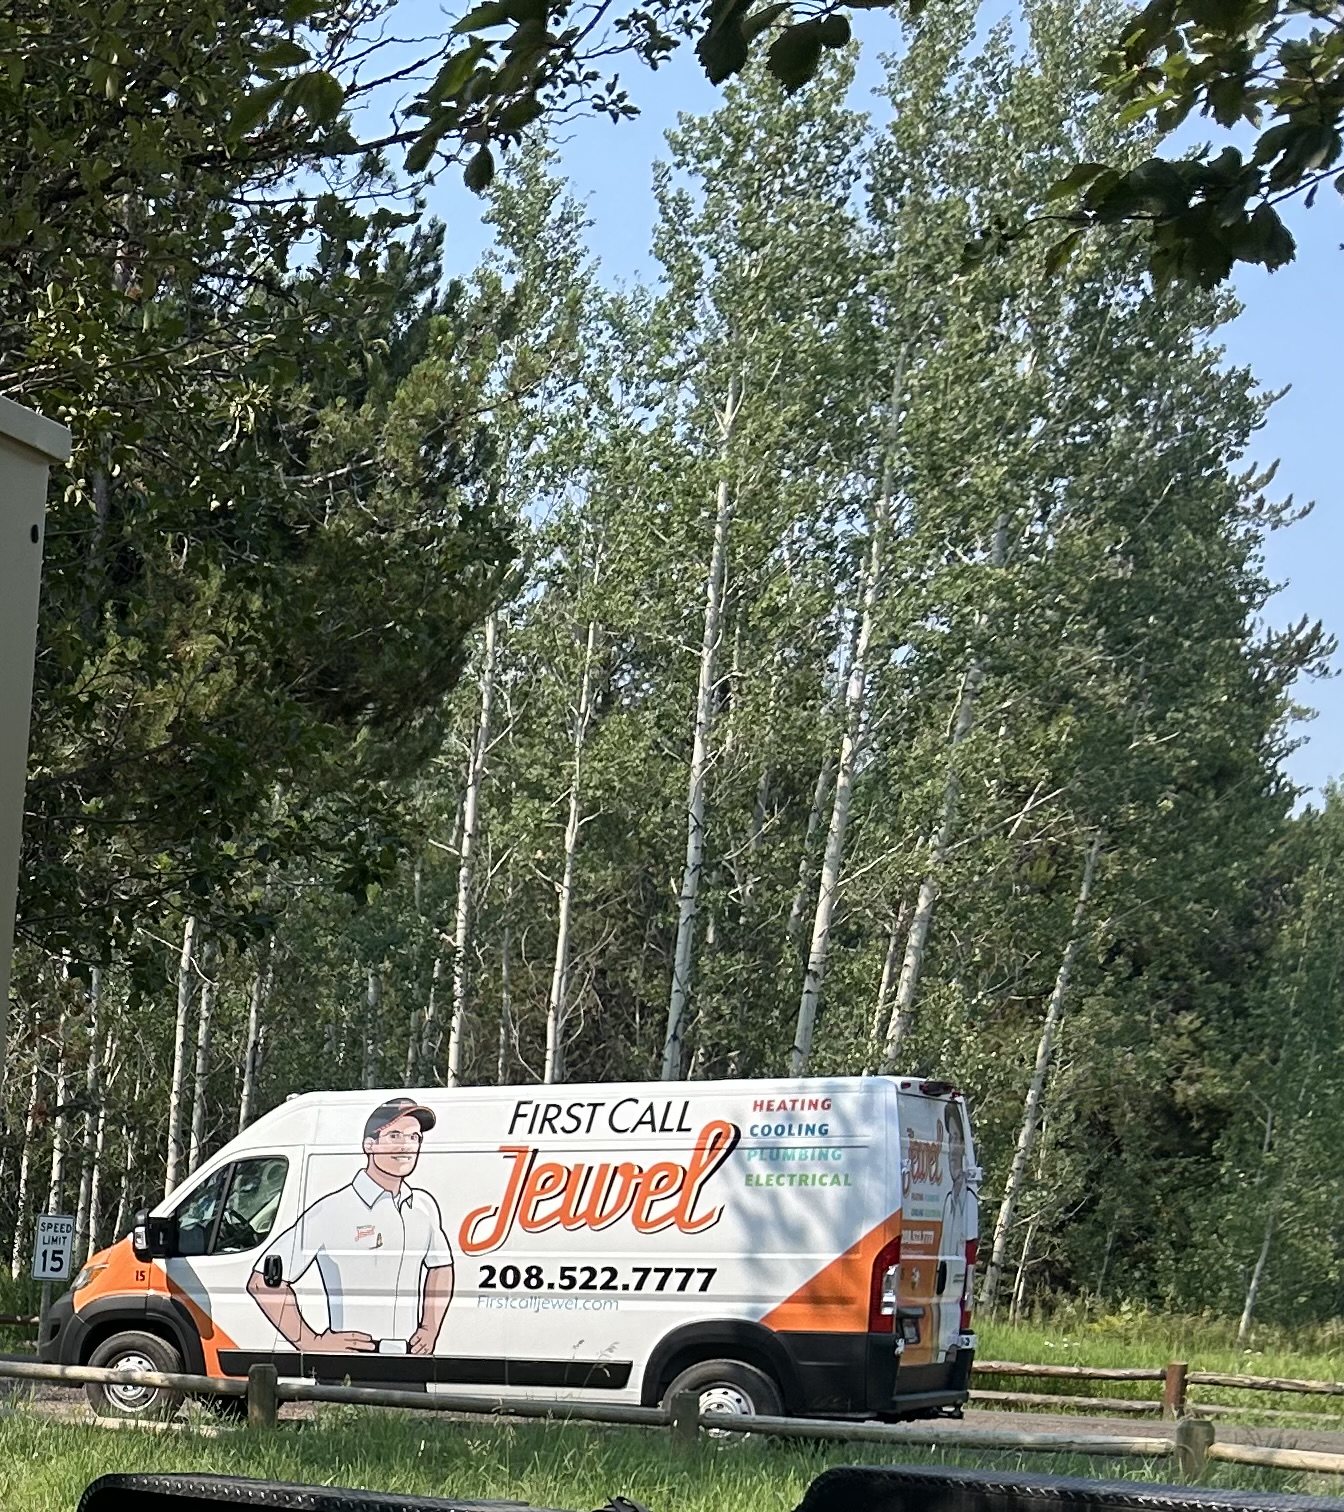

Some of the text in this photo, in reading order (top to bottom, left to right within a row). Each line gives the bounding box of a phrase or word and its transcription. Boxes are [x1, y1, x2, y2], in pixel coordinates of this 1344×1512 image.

[752, 1098, 833, 1113] HEATING
[507, 1097, 693, 1135] FIRST CALL
[749, 1123, 830, 1138] COOLING
[746, 1148, 843, 1162] PLUMBING
[458, 1119, 742, 1257] Jewel
[744, 1173, 853, 1188] ELECTRICAL
[39, 1221, 72, 1234] SPEED
[42, 1236, 67, 1247] LIMIT
[41, 1249, 64, 1273] 15
[135, 1270, 146, 1282] 15
[478, 1264, 718, 1293] 208.522.7777
